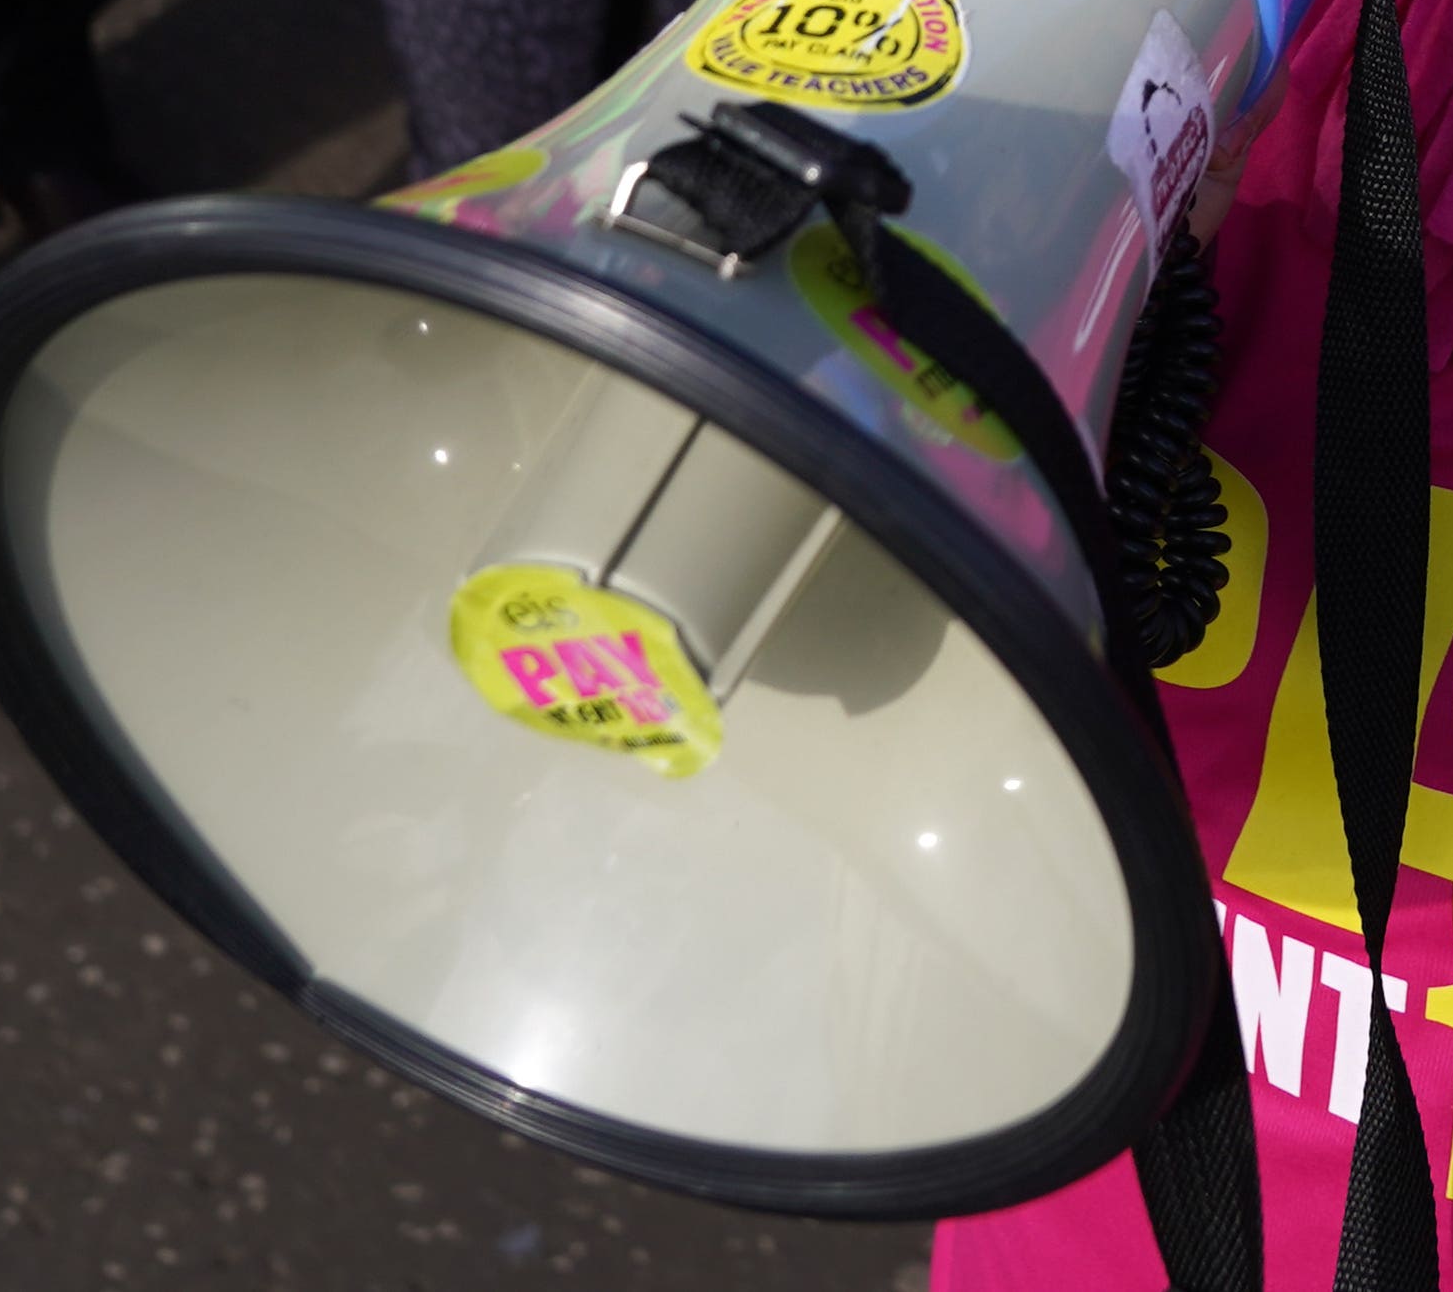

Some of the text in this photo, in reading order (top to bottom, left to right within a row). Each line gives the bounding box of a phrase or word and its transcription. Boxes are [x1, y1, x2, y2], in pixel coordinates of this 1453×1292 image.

[758, 3, 902, 58] 10%
[766, 65, 929, 98] TEACHERS
[499, 630, 663, 710] PAY
